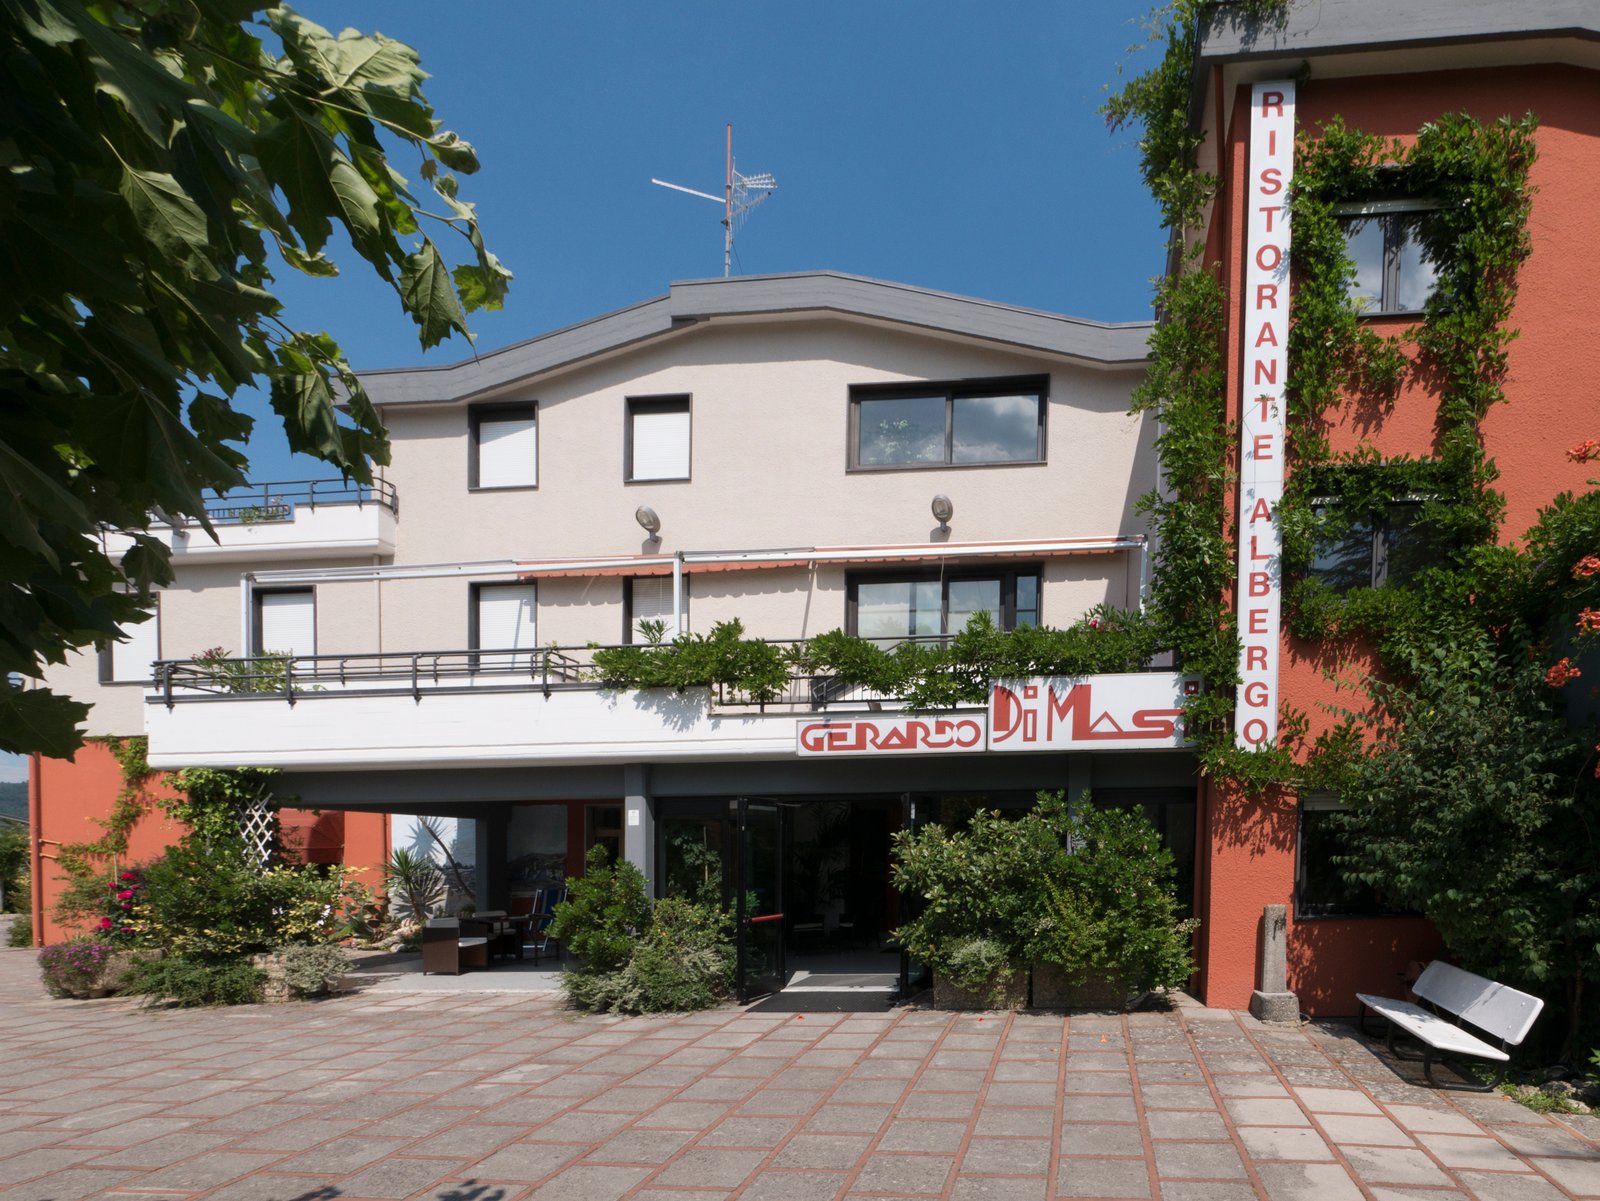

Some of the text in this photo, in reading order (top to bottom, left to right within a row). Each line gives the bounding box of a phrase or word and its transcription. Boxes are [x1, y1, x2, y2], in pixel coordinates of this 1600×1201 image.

[1242, 91, 1285, 745] RISTORANTE ALBERGO
[800, 719, 982, 752] GERARDO
